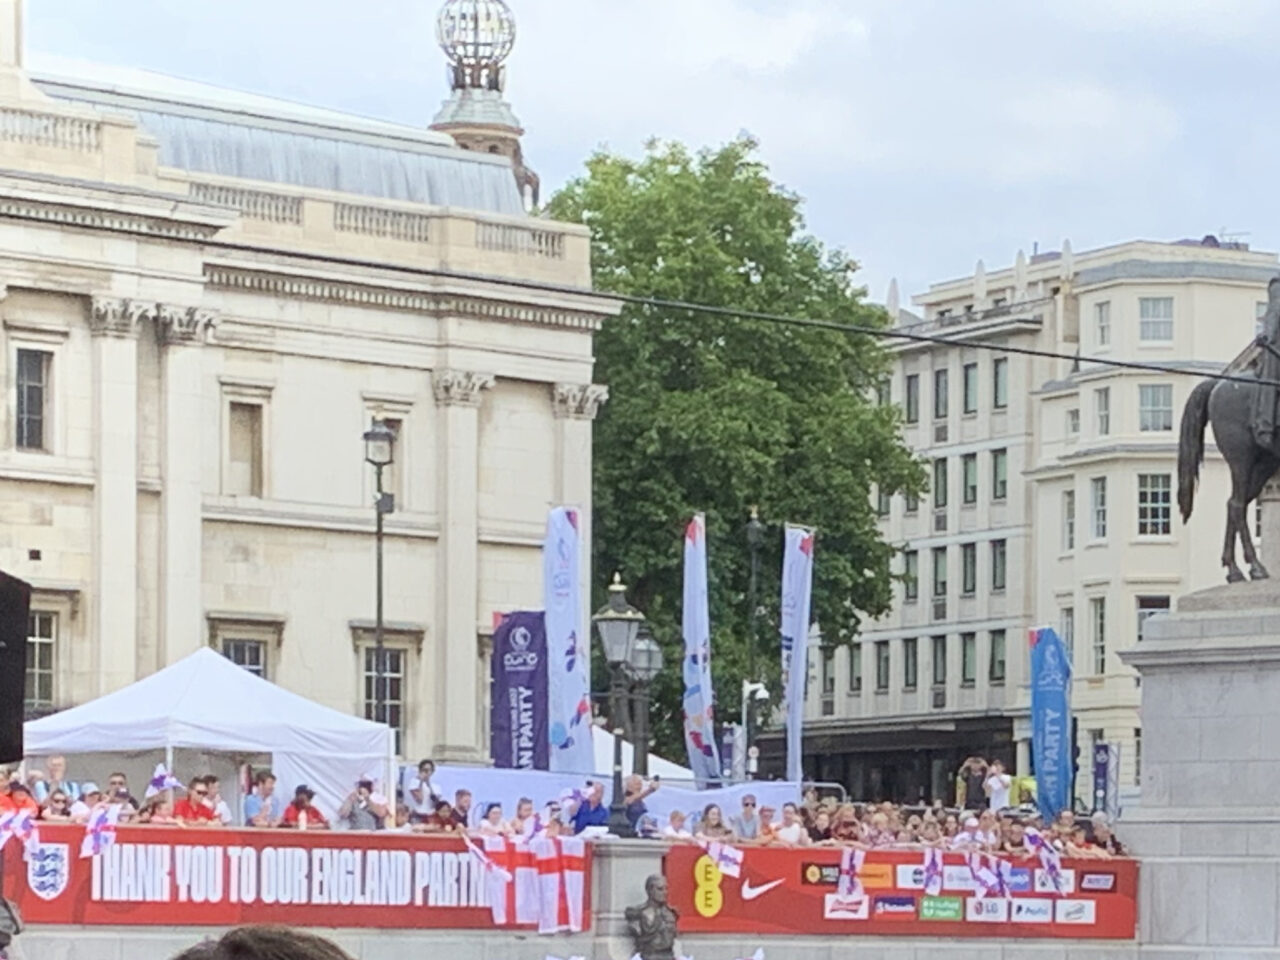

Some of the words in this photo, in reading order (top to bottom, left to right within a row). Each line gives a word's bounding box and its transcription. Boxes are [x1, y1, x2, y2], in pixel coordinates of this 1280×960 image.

[518, 686, 534, 747] PARTY
[1042, 708, 1061, 771] PARTY
[91, 843, 170, 902] THANK
[174, 844, 224, 903] YOU
[227, 846, 258, 903] TO
[260, 846, 309, 904] OUR
[311, 847, 412, 906] ENGLAND
[415, 851, 492, 908] PARTN
